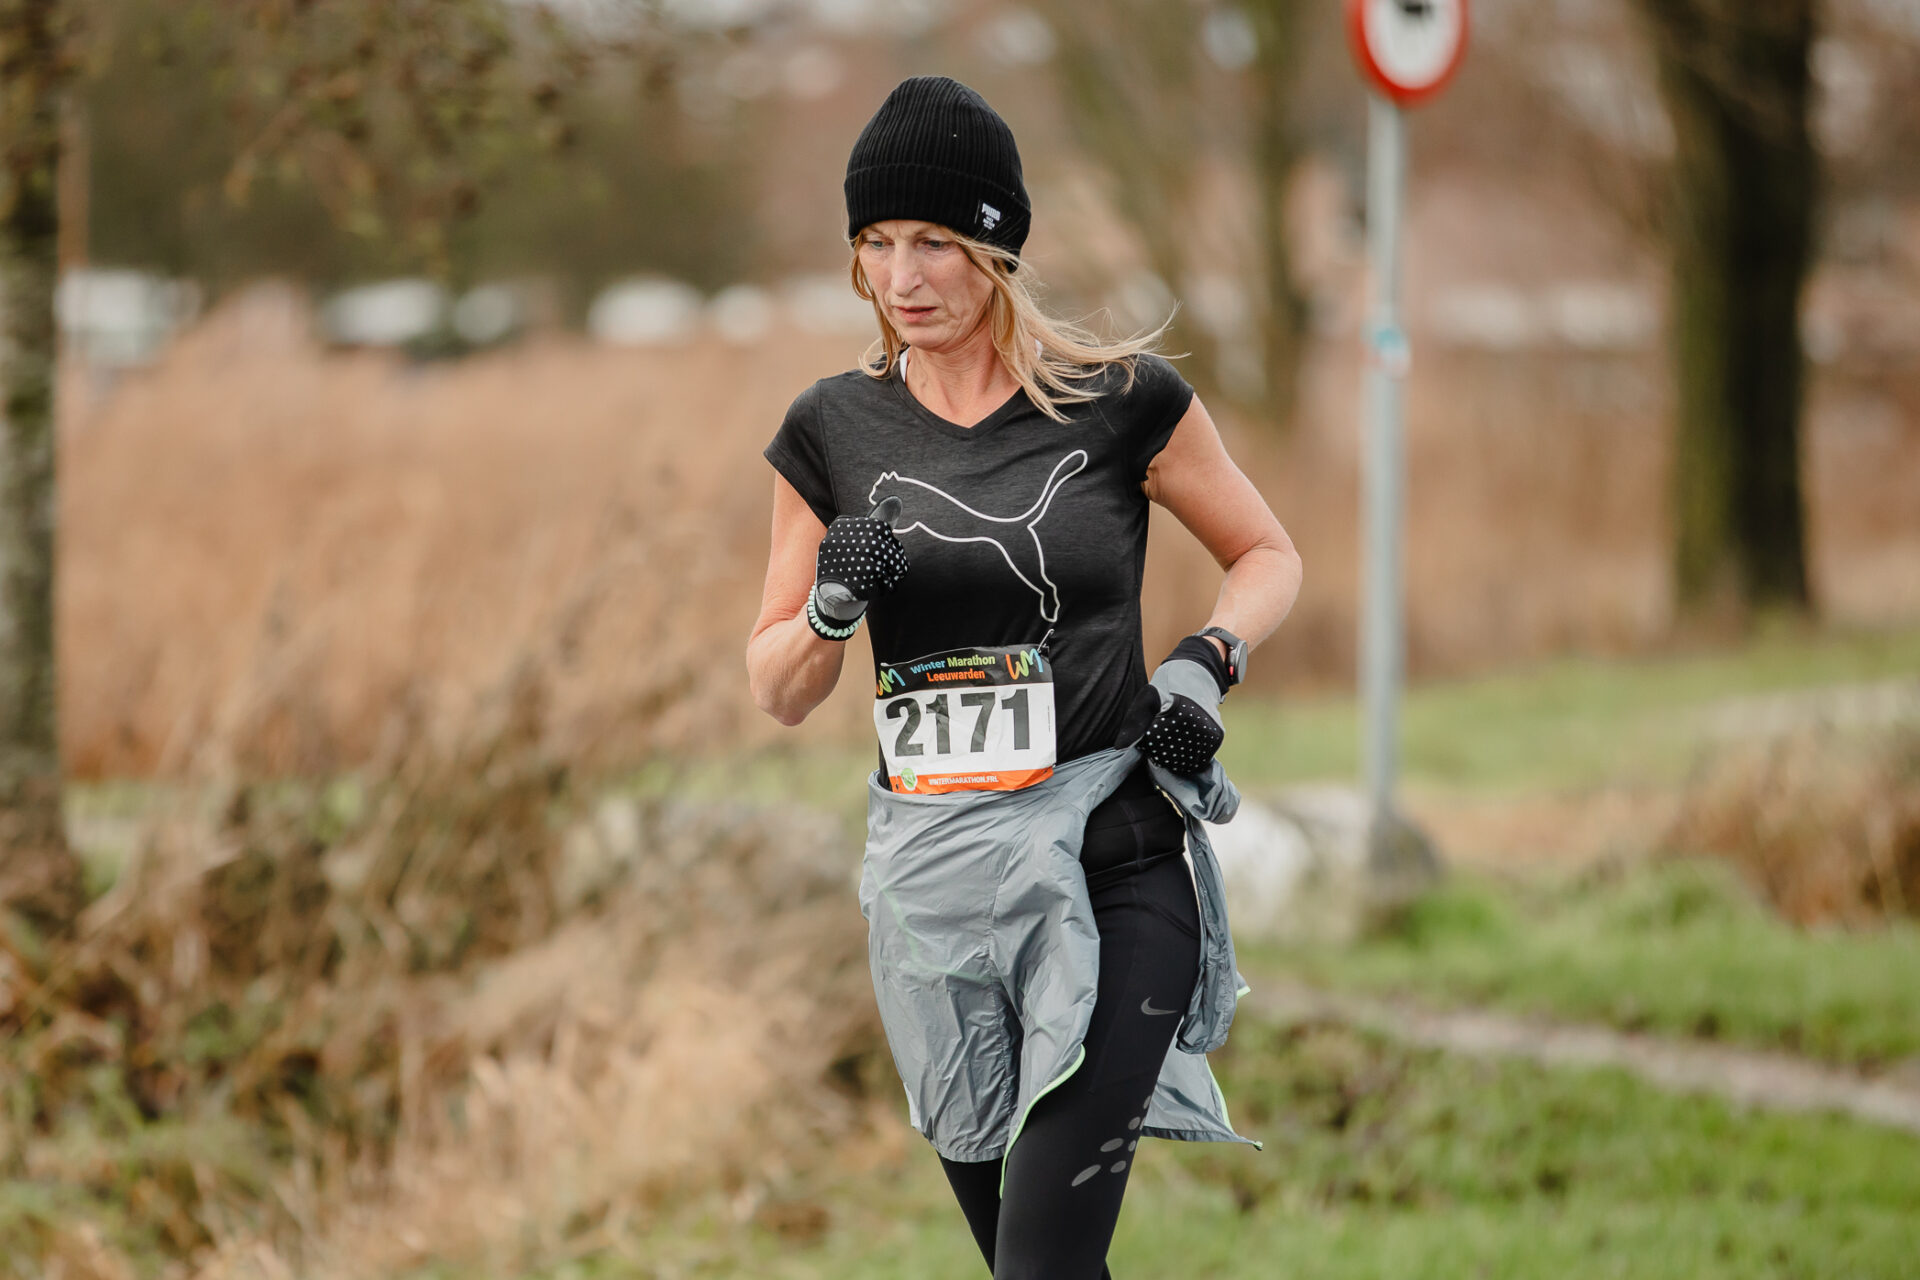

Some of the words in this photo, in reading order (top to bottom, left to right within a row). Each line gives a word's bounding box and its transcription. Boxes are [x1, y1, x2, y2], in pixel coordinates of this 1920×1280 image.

[910, 660, 946, 675] Winter
[947, 655, 996, 667] Marathon
[927, 668, 986, 682] Leeuwarden
[886, 688, 1031, 757] 2171
[928, 775, 999, 786] WINTERMARATHON.FRL
